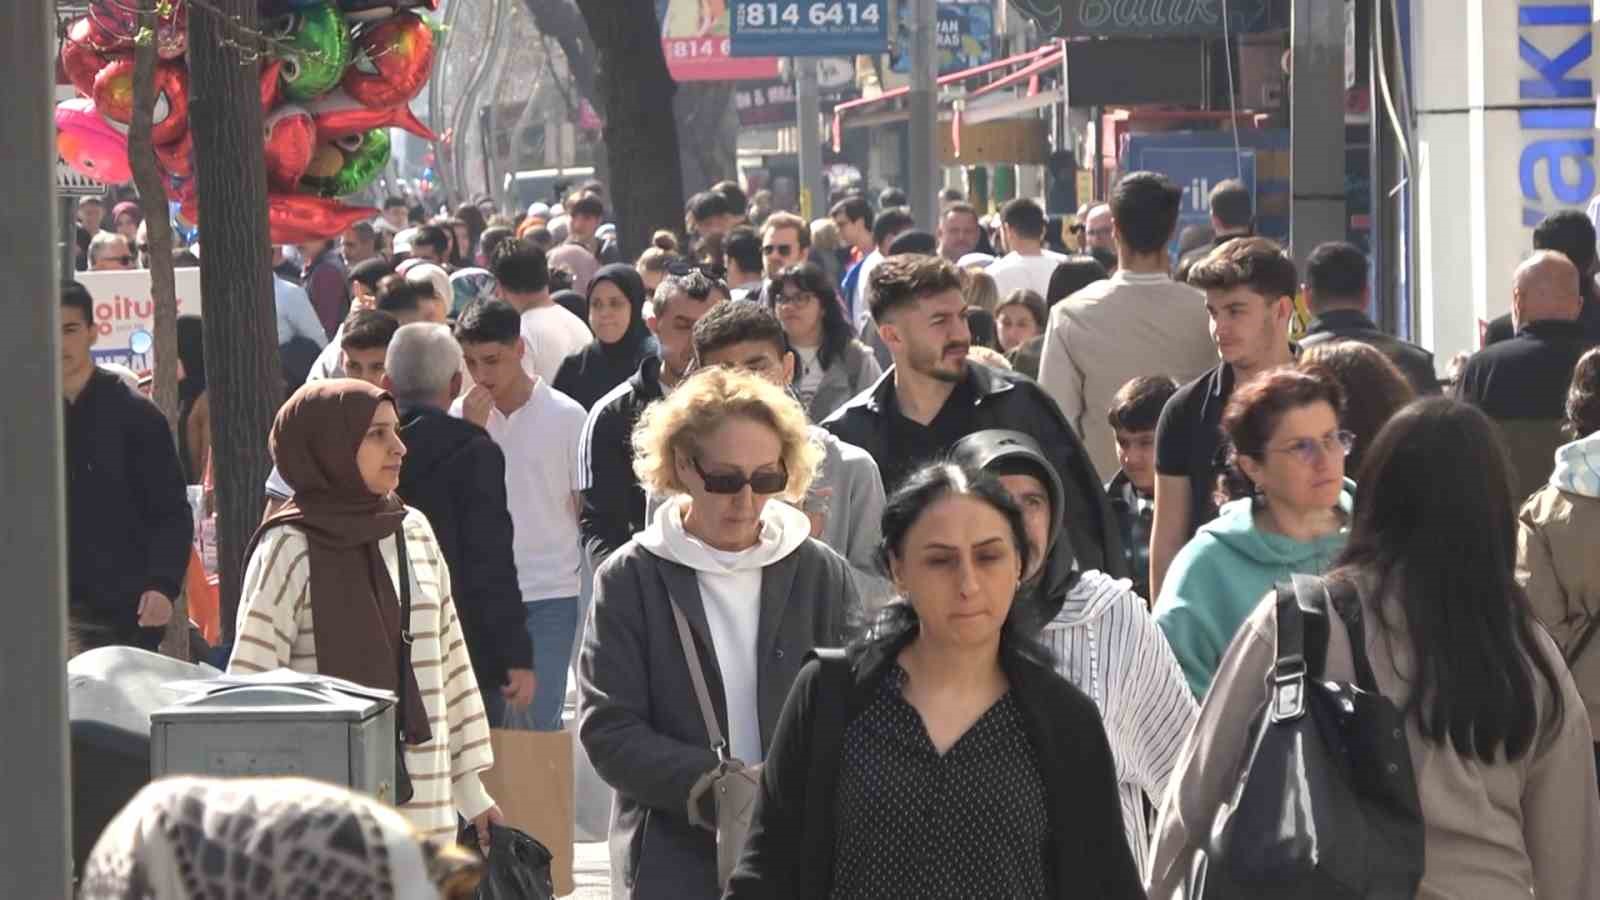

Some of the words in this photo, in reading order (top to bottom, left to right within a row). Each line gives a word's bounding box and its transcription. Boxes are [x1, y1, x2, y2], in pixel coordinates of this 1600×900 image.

[746, 2, 799, 26] 814
[808, 2, 880, 25] 6414
[671, 40, 713, 57] 814
